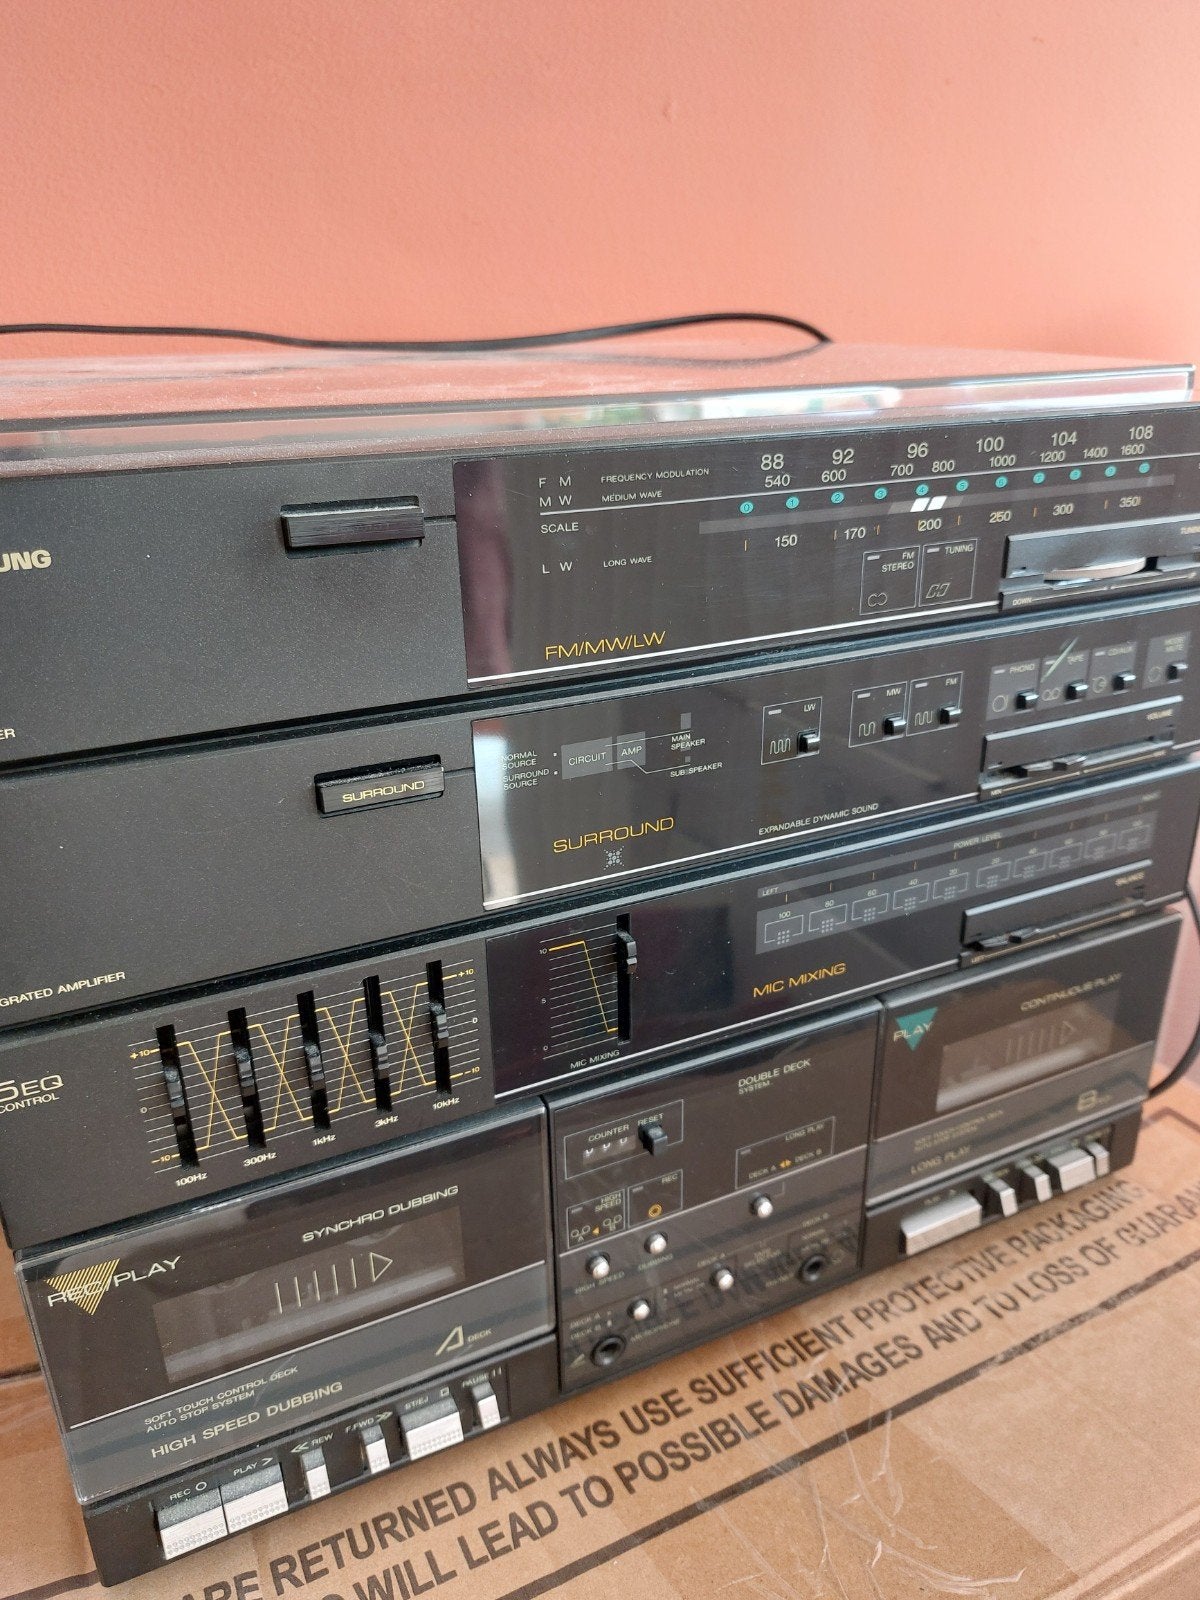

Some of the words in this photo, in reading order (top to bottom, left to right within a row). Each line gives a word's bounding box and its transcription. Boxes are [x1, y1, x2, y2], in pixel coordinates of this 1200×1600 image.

[761, 454, 784, 470] 88
[832, 449, 854, 465] 92
[907, 443, 928, 458] 96
[976, 438, 1004, 453] 100
[1052, 432, 1077, 446] 104
[1129, 426, 1153, 440] 108
[765, 475, 790, 488] 540
[821, 470, 846, 482] 600
[890, 465, 913, 476] 700
[932, 461, 954, 472] 800
[989, 455, 1015, 467] 1000
[1040, 451, 1065, 462] 1200
[1083, 448, 1107, 459] 1400
[1121, 444, 1145, 455] 1600
[601, 473, 653, 483] FREQUENCY
[656, 469, 709, 479] MODULATION
[602, 493, 636, 502] MEDIUM
[640, 491, 662, 499] WAVE
[541, 522, 579, 533] SCALE
[775, 535, 797, 547] 150
[844, 528, 866, 540] 170
[920, 519, 941, 530] 200
[989, 511, 1011, 523] 250
[1053, 504, 1073, 515] 300
[1119, 497, 1138, 507] 350
[945, 543, 974, 555] TUNING
[603, 559, 627, 567] LONG
[630, 556, 652, 564] WAVE
[882, 562, 914, 572] STEREO
[545, 631, 666, 660] FM/MW/LW
[1010, 664, 1034, 674] PHONO
[887, 688, 900, 696] MW
[804, 704, 816, 712] LW
[671, 738, 705, 750] SPEAKER
[672, 733, 691, 743] MAIN
[501, 751, 537, 761] NORMAL
[621, 746, 642, 756] AMP
[503, 759, 536, 770] SOURCE
[569, 752, 606, 765] CIRCUIT
[503, 769, 549, 782] SURROUND
[670, 769, 685, 778] SUB
[688, 762, 722, 774] SPEAKER
[342, 781, 424, 802] SURROUND
[504, 779, 538, 790] SOURCE
[759, 817, 811, 836] EXPANDABLE
[813, 810, 850, 824] DYNAMIC
[852, 803, 879, 815] SOUND
[553, 817, 674, 853] SURROUND
[763, 887, 778, 895] LEFT
[953, 838, 979, 848] POWER
[982, 833, 1002, 842] LEVEL
[779, 911, 790, 919] 100
[58, 972, 126, 994] AMPLIFIER
[753, 980, 784, 997] MIC
[789, 963, 846, 988] MIXING
[893, 1021, 934, 1042] PLAY
[570, 1059, 587, 1069] MIC
[589, 1050, 619, 1064] MIXING
[738, 1067, 781, 1087] DOUBLE
[784, 1058, 811, 1073] DECK
[739, 1080, 770, 1095] SYSTEM
[140, 1106, 148, 1114] 0
[638, 1113, 664, 1125] RESET
[588, 1124, 629, 1142] COUNTER
[785, 1129, 806, 1141] LONG
[176, 1172, 208, 1186] 100Hz
[244, 1152, 276, 1167] 300Hz
[312, 1133, 336, 1146] 1kHz
[375, 1114, 399, 1128] 3kHz
[432, 1095, 460, 1110] 10kHz
[662, 1174, 677, 1184] REC
[601, 1192, 621, 1203] HIGH
[595, 1198, 621, 1212] SPEED
[303, 1210, 384, 1242] SYNCHRO
[388, 1186, 458, 1215] DUBBING
[467, 1328, 492, 1343] DECK
[269, 1480, 477, 1595] RETURNED
[487, 1420, 621, 1501] ALWAYS
[619, 1389, 693, 1435] USE
[689, 1314, 855, 1405] SUFFICIENT
[851, 1244, 1015, 1331] PROTECTIVE
[1007, 1180, 1145, 1257] PACKAGING
[145, 1413, 172, 1425] SOFT
[176, 1396, 214, 1415] TOUCH
[217, 1380, 268, 1399] CONTROL
[270, 1366, 298, 1382] DECK
[146, 1418, 176, 1433] AUTO
[180, 1407, 210, 1422] STOP
[212, 1390, 255, 1410] SYSTEM
[353, 1549, 457, 1600] WILL
[457, 1502, 559, 1570] LEAD
[559, 1475, 614, 1518] TO
[614, 1400, 781, 1495] POSSIBLE
[773, 1334, 923, 1420] DAMAGES
[920, 1307, 982, 1350] AND
[973, 1290, 1021, 1320] TO
[1014, 1255, 1089, 1303] LOSS
[1079, 1236, 1121, 1267] OF
[152, 1435, 196, 1458] HIGH
[203, 1412, 260, 1440] SPEED
[266, 1382, 343, 1418] DUBBING
[312, 1433, 334, 1447] REW
[233, 1462, 258, 1477] PLAY
[170, 1488, 191, 1501] REC
